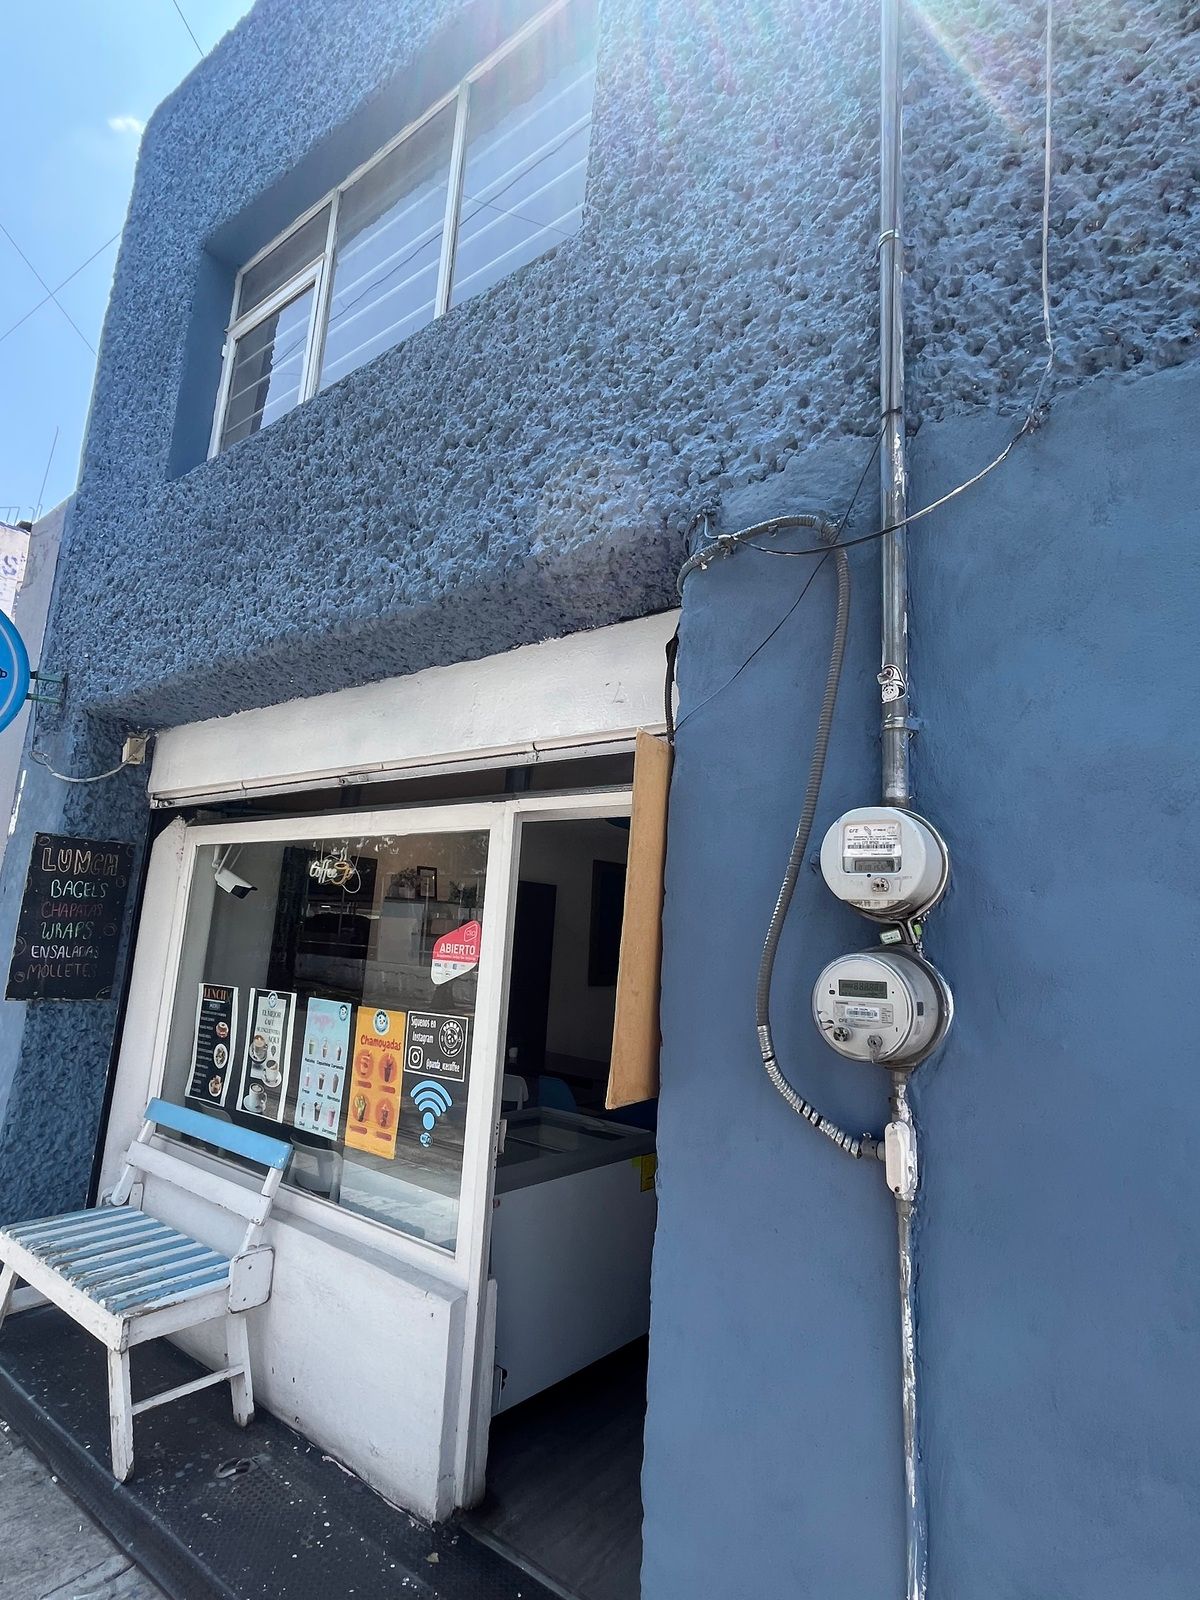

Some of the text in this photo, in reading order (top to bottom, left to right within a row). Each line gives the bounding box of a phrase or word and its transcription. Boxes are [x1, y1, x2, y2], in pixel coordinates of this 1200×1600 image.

[42, 848, 119, 876] LUNCH
[310, 859, 338, 884] Coffee
[51, 880, 109, 899] BAGELS
[41, 900, 104, 919] CHAPATAS
[40, 921, 95, 940] WRAPS
[31, 945, 100, 959] ENSALADAS
[440, 942, 476, 956] ABIERTO
[26, 963, 98, 979] MOLLETES
[430, 1020, 437, 1029] en
[361, 1034, 402, 1052] Chamoyadas
[412, 1031, 434, 1045] Instagram
